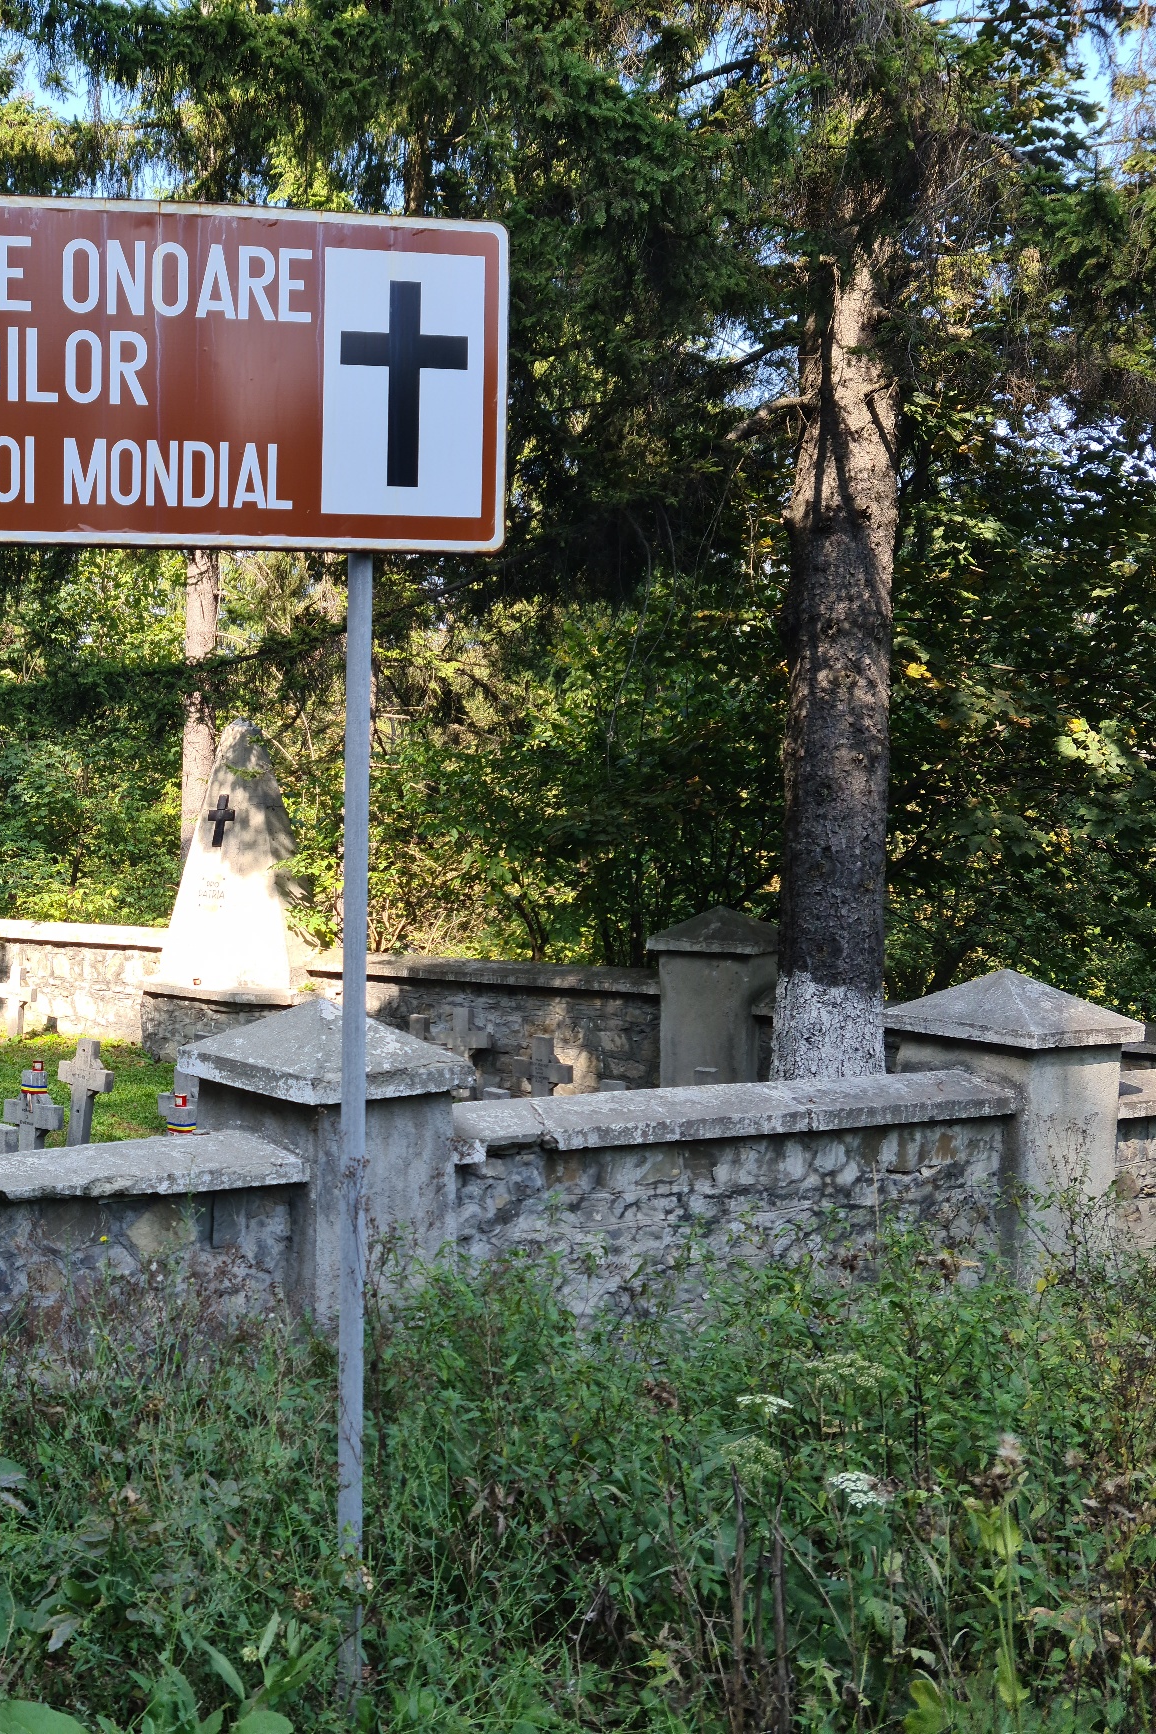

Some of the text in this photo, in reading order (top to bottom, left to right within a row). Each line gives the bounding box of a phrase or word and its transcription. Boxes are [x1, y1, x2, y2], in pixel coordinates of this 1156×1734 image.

[62, 237, 313, 324] ONOARE
[63, 437, 293, 510] MONDIAL
[198, 889, 225, 899] PATRIA
